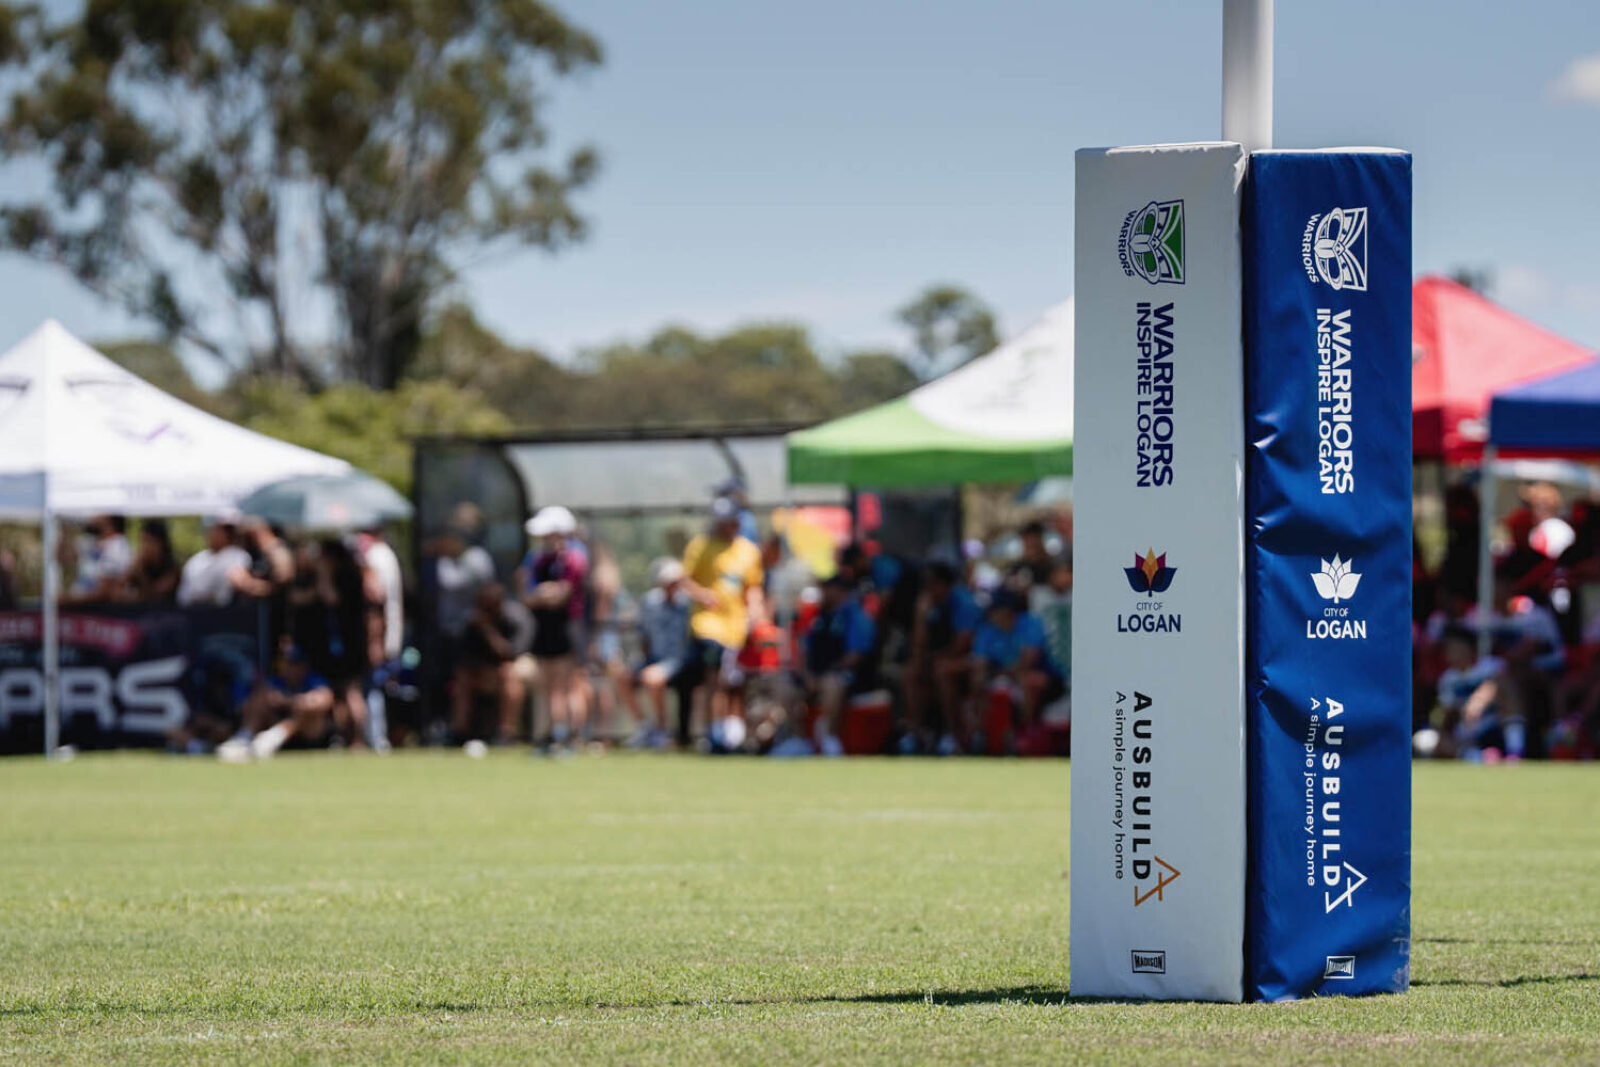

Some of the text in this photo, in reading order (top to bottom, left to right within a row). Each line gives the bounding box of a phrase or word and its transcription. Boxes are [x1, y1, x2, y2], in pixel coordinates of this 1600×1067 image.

[1118, 210, 1138, 277] WARRIORS
[1302, 213, 1321, 283] WARRIORS
[1136, 302, 1152, 488] INSPIRE LOGAN
[1153, 302, 1175, 487] WARRIORS
[1316, 308, 1335, 495] INSPIRE LOGAN
[1331, 309, 1354, 494] WARRIORS
[1117, 614, 1181, 632] LOGAN
[1136, 602, 1163, 611] CITY OF
[1307, 619, 1367, 639] LOGAN
[1323, 607, 1349, 617] CITY OF
[1112, 691, 1126, 880] A simple journey home
[1132, 691, 1152, 880] AUSBUILD
[1303, 697, 1321, 886] A simple journey home
[1322, 697, 1345, 886] AUSBUILD
